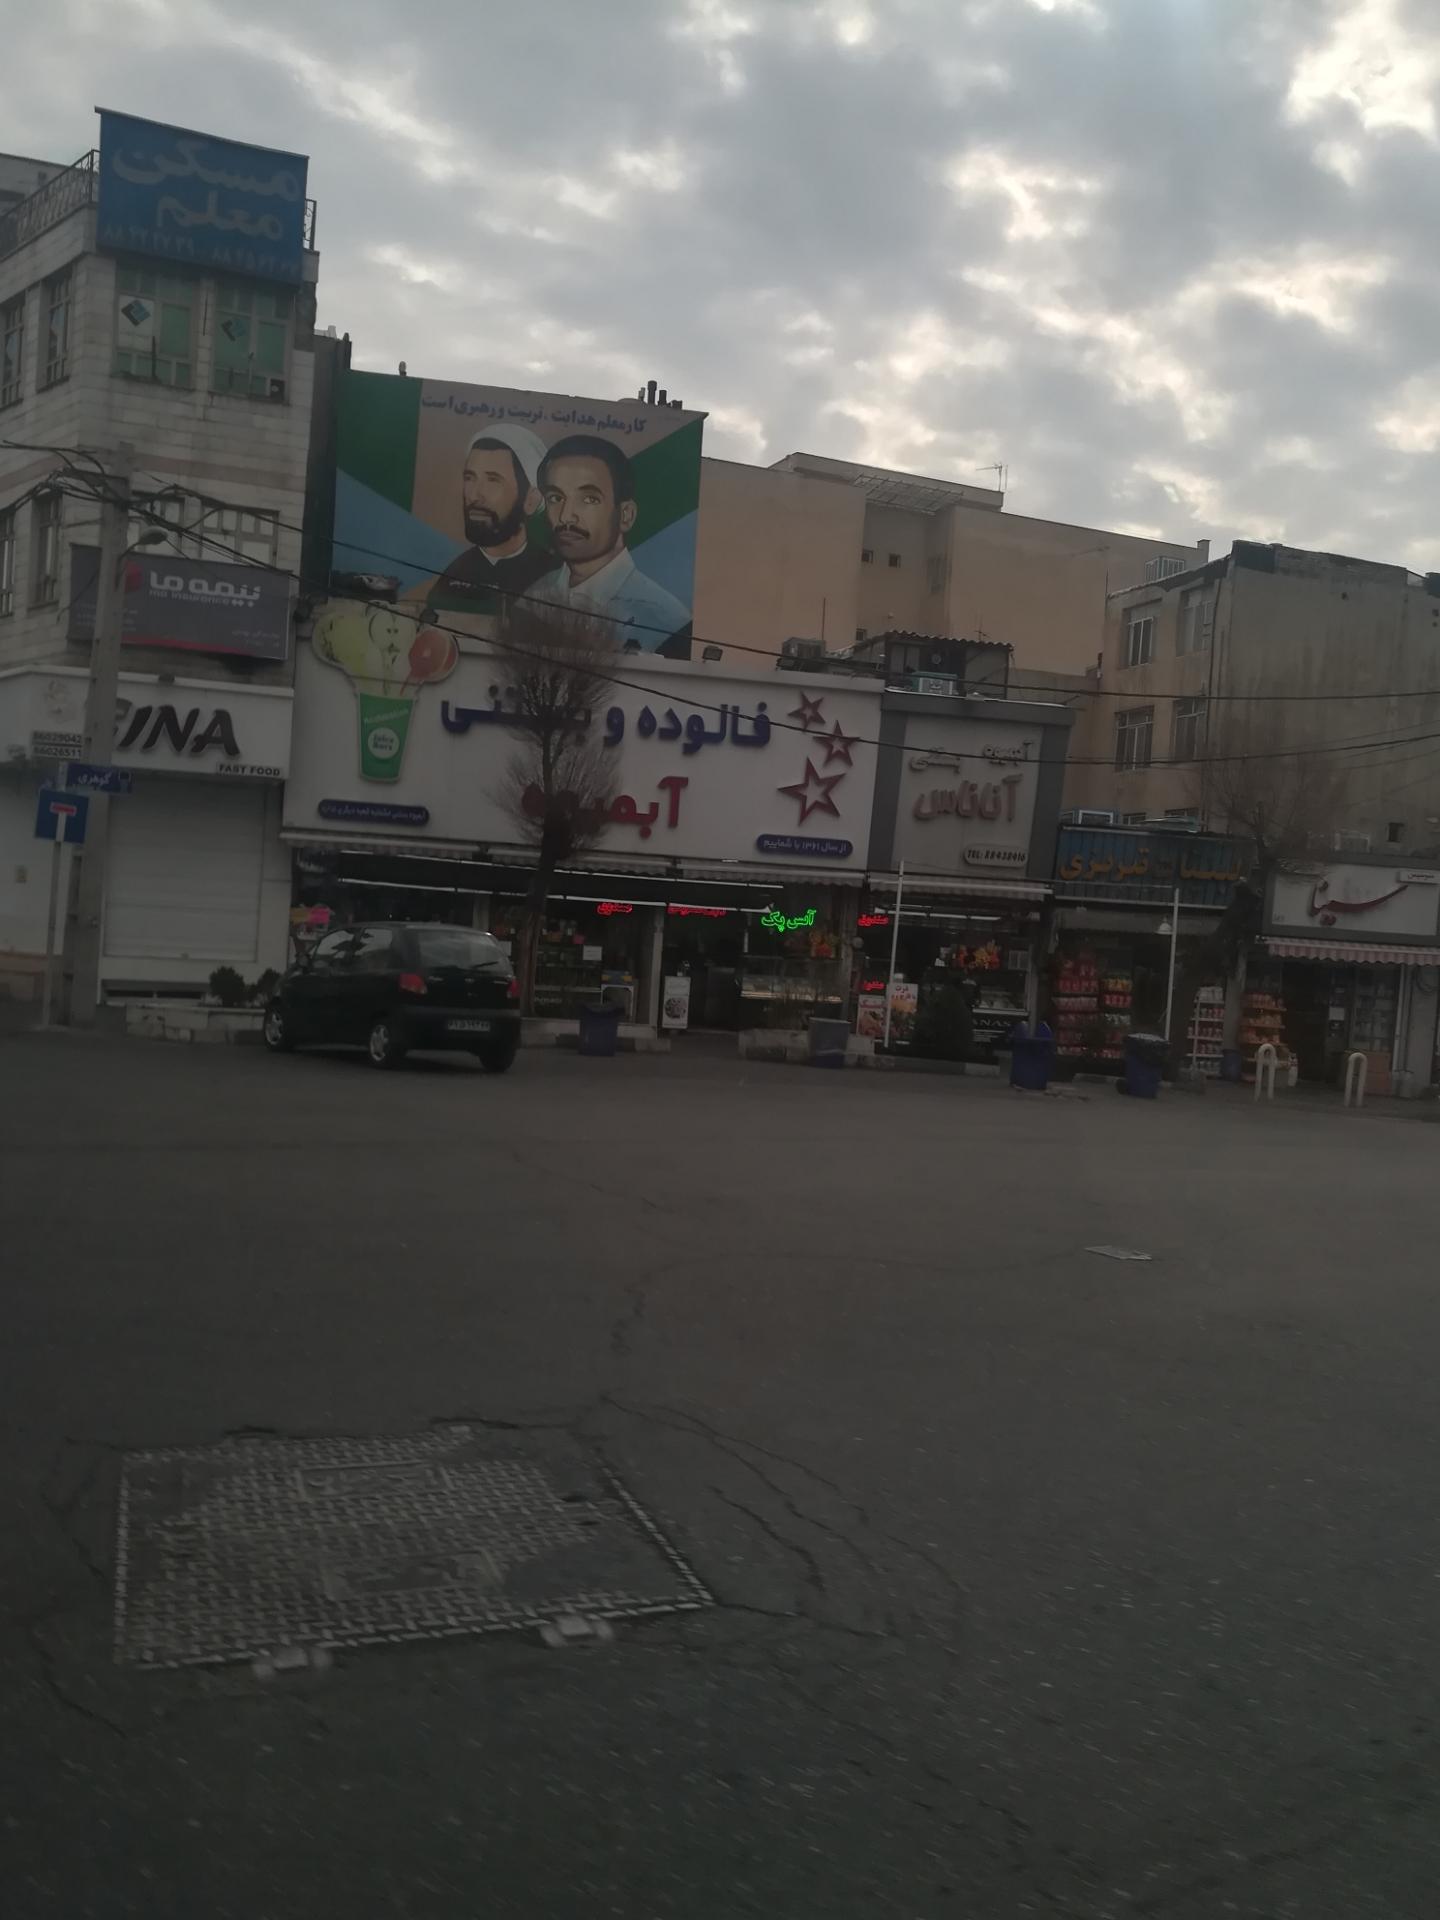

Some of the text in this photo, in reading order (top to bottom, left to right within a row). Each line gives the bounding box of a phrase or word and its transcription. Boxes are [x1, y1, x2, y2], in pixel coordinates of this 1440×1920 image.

[112, 141, 301, 201] مسکن
[157, 191, 282, 240] معلم
[422, 395, 453, 408] است
[597, 414, 625, 432] معلم
[624, 416, 647, 434] کار
[150, 570, 262, 608] بیمه ما
[113, 697, 240, 757] INA
[602, 706, 625, 747] و
[638, 701, 771, 755] فالوده
[219, 764, 280, 776] FAST FOOD
[821, 842, 837, 853] سال
[761, 911, 785, 932] پک
